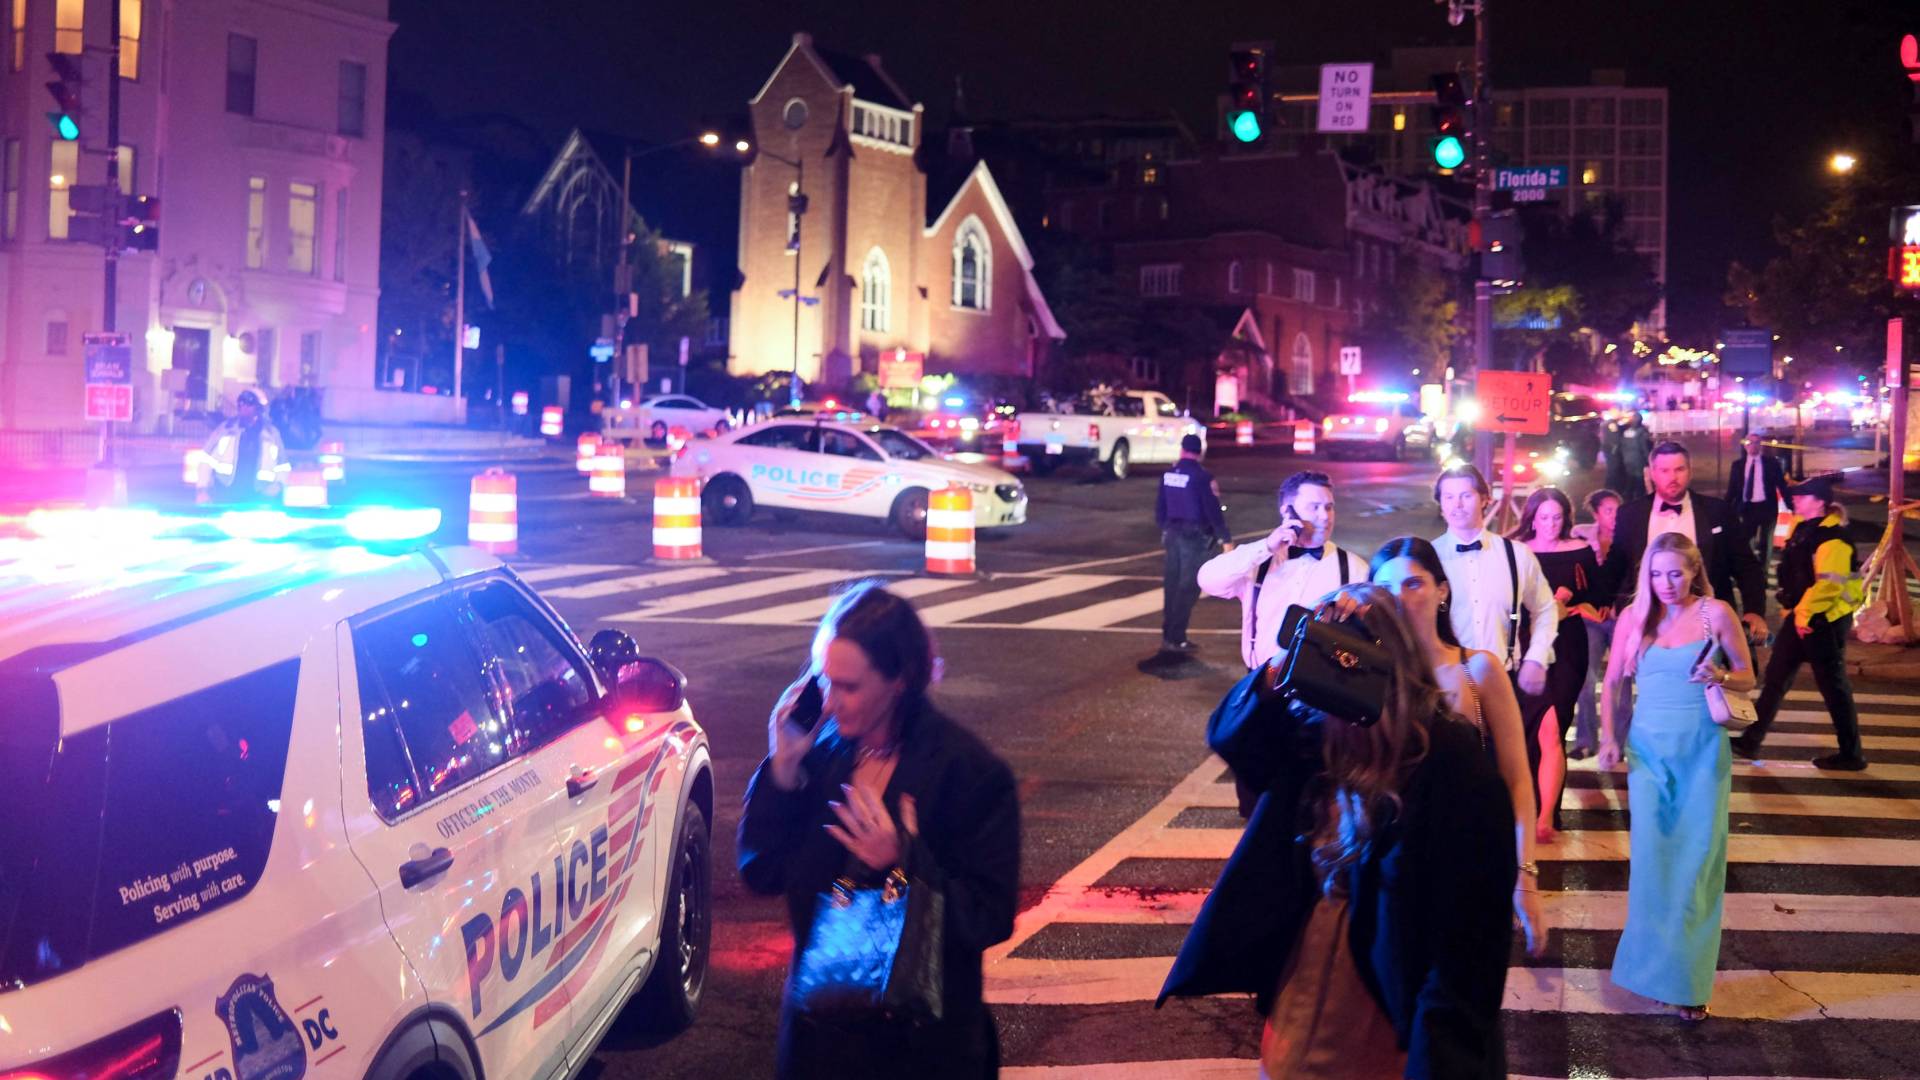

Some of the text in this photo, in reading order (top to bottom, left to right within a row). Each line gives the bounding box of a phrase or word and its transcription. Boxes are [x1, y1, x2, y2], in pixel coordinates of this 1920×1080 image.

[1334, 70, 1358, 84] NO
[1331, 87, 1360, 98] TURN
[1335, 101, 1353, 112] ON
[1332, 115, 1354, 126] RED
[1499, 169, 1547, 188] Florida
[1513, 189, 1545, 202] 2000
[1481, 396, 1542, 411] DETOUR
[752, 464, 840, 488] POLICE
[436, 769, 542, 839] OFFICER OF THE MONTH
[119, 847, 238, 905] Policing with purpose.
[153, 873, 246, 923] Serving with care.
[460, 822, 608, 1020] POLICE
[302, 1008, 338, 1052] DC
